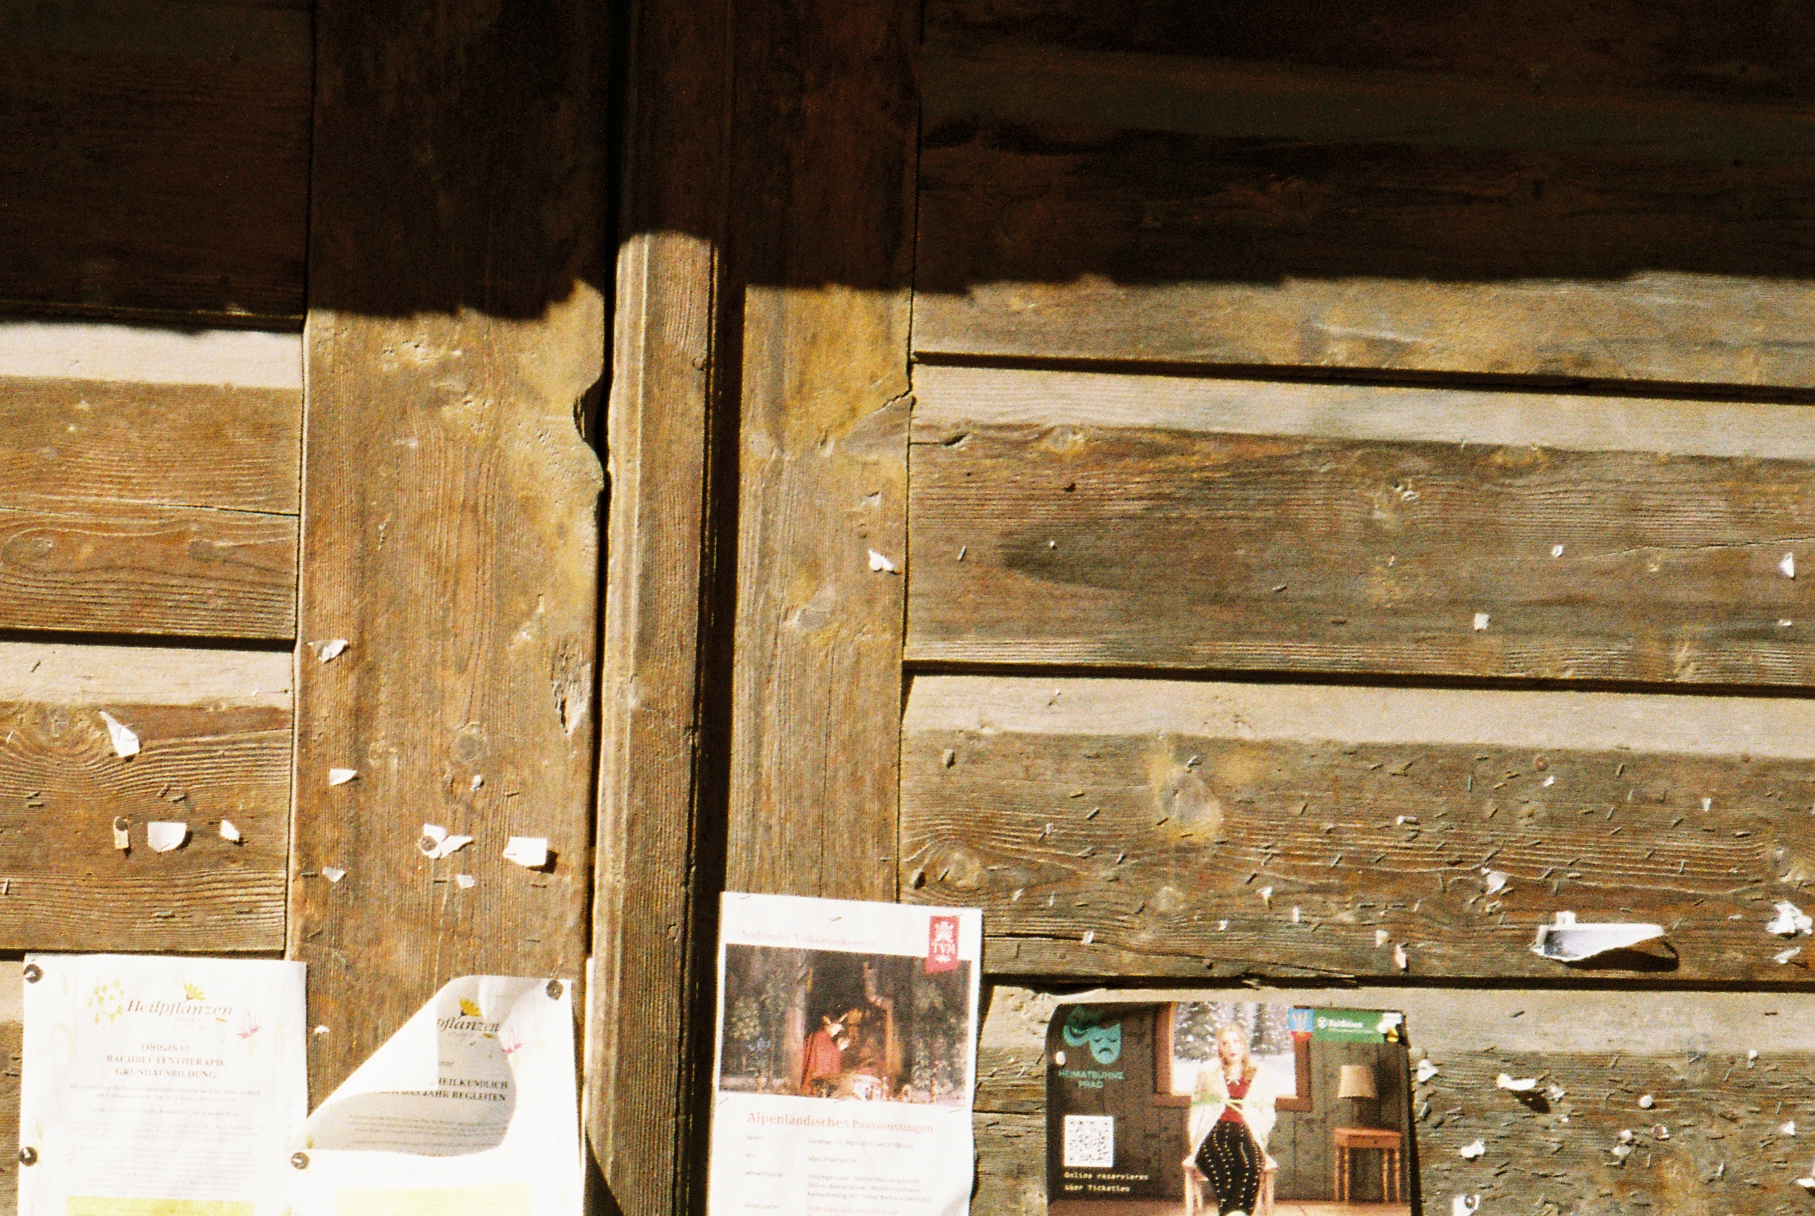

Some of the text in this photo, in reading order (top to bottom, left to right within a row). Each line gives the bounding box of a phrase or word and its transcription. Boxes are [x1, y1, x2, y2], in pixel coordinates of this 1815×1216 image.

[126, 1000, 234, 1018] Heilpflanzen
[1078, 1080, 1104, 1089] PRAD
[747, 1112, 934, 1135] Alpenländisches Passionssingen
[1063, 1171, 1093, 1180] Online
